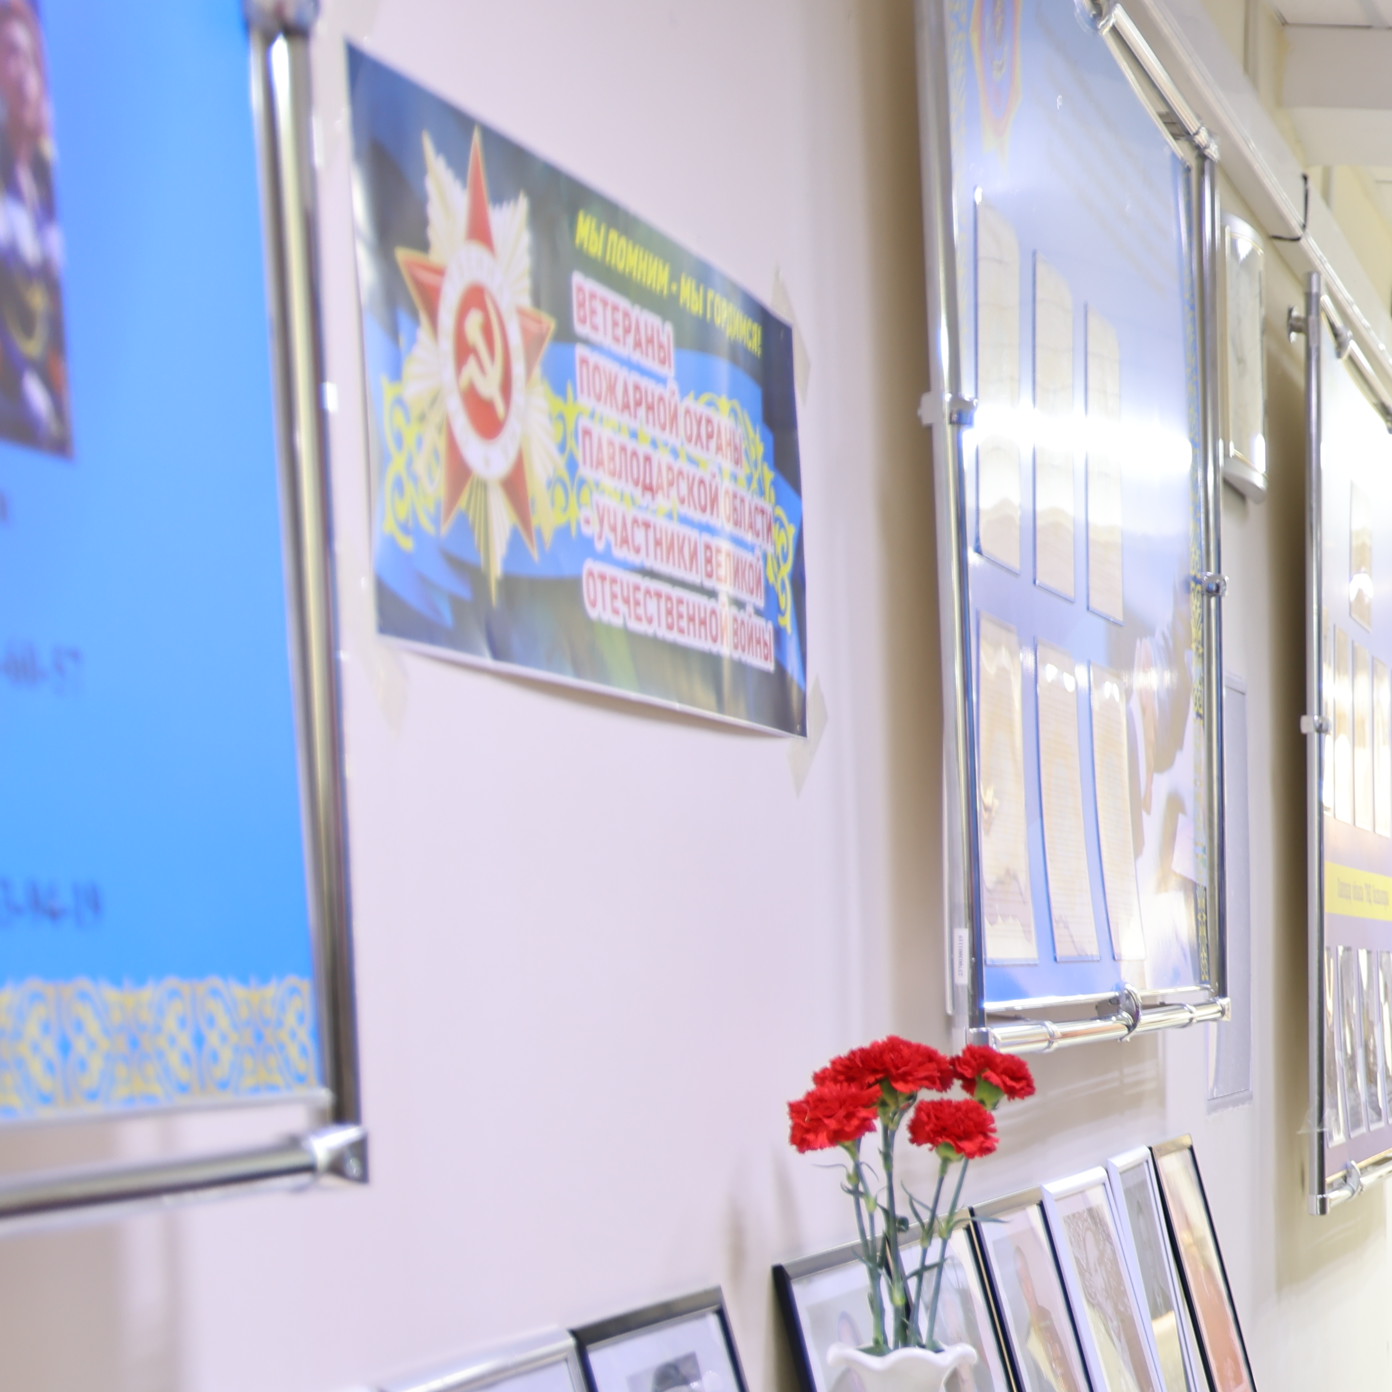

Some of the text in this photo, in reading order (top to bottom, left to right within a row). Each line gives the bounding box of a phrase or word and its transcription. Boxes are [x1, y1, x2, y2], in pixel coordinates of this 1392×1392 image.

[576, 210, 606, 259] МЫ
[606, 228, 670, 298] ПОМНИМ
[680, 272, 704, 317] МЫ
[575, 281, 674, 372] ВЕТЕРАНЫ
[578, 354, 744, 468] ПОЖАРНОЙ ОХРАНЫ
[581, 426, 774, 546] ПАВЛОДАРСКОЙ ОБЛАСТИ
[595, 499, 699, 575] УЧАСТНИКИ
[703, 542, 763, 600] ВЕЛИКОЙ
[585, 566, 773, 664] ОТЕЧЕСТВЕННОЙ ВОЙНЫ
